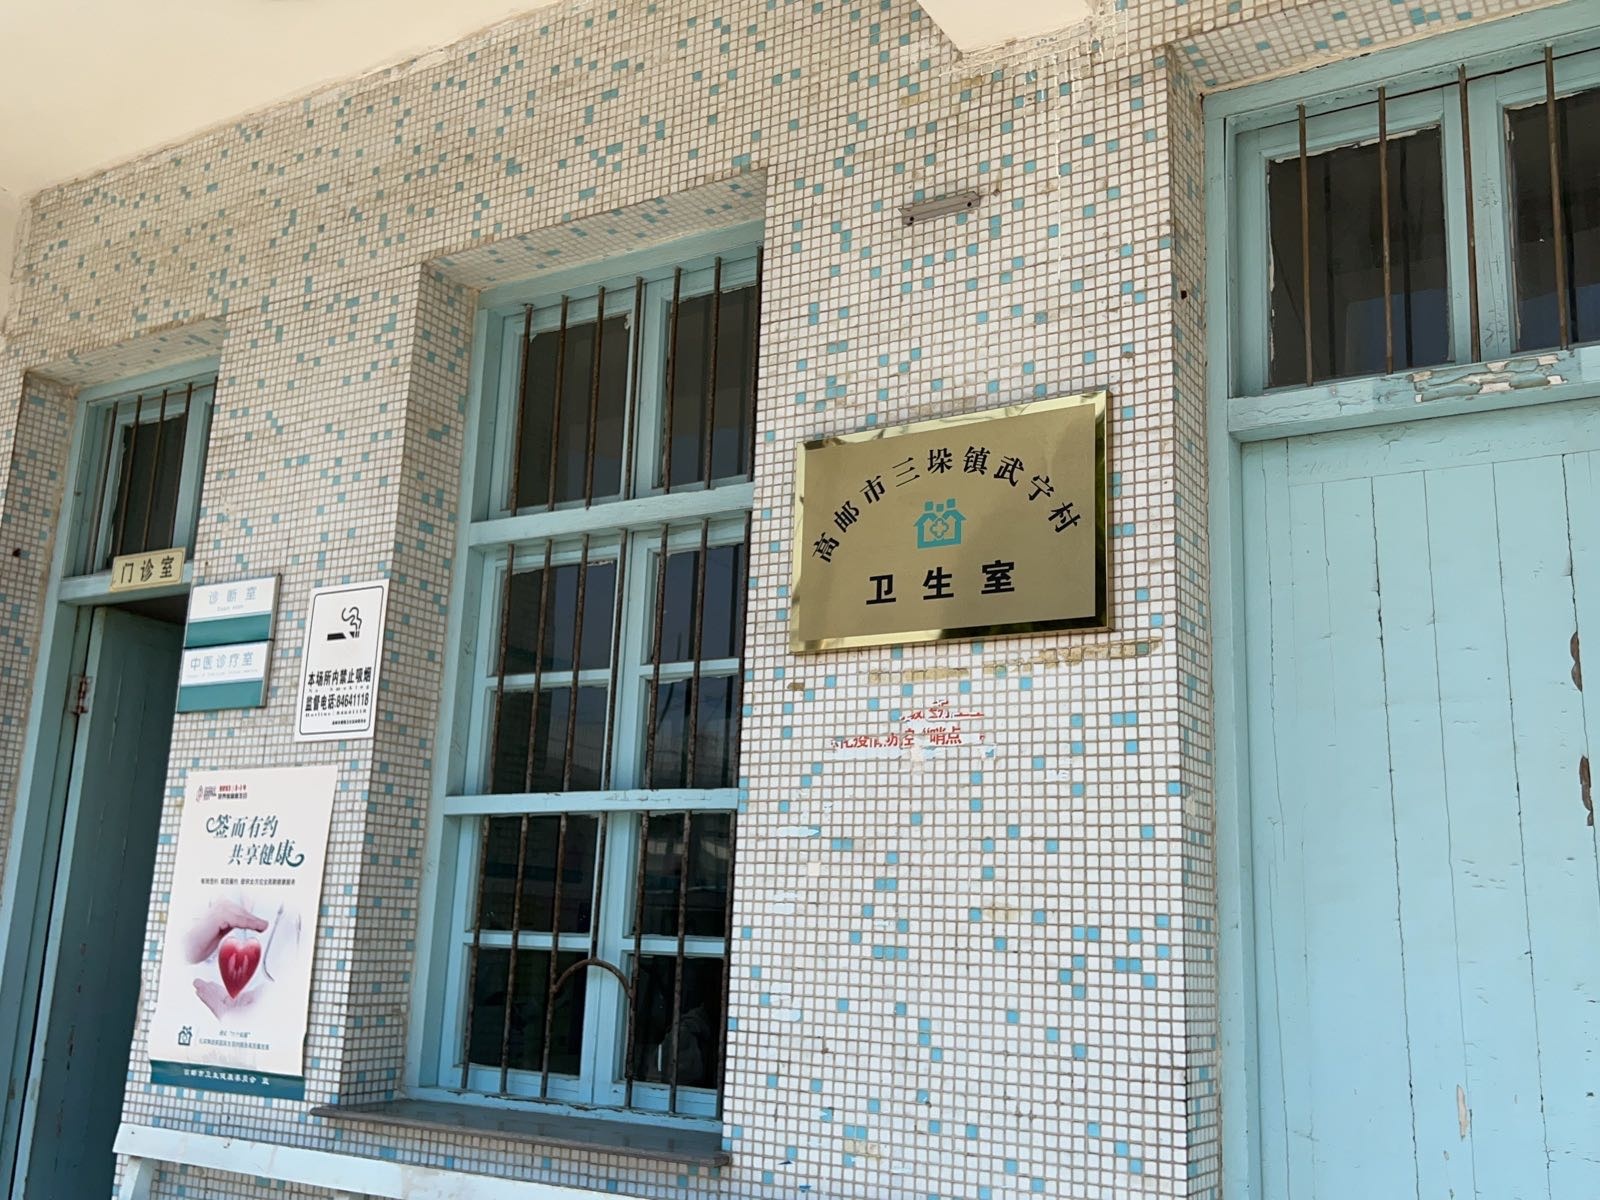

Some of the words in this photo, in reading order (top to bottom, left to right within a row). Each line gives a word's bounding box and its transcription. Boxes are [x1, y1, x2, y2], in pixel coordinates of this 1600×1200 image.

[812, 446, 1081, 562] 高邮市三垛镇武宁村
[120, 555, 175, 584] 门诊室
[866, 560, 1015, 605] 卫生室
[190, 651, 253, 670] 中医诊疗室
[308, 667, 372, 687] 本场所内禁止吸烟
[206, 814, 279, 838] 签而有约
[228, 839, 305, 867] 共享健康
